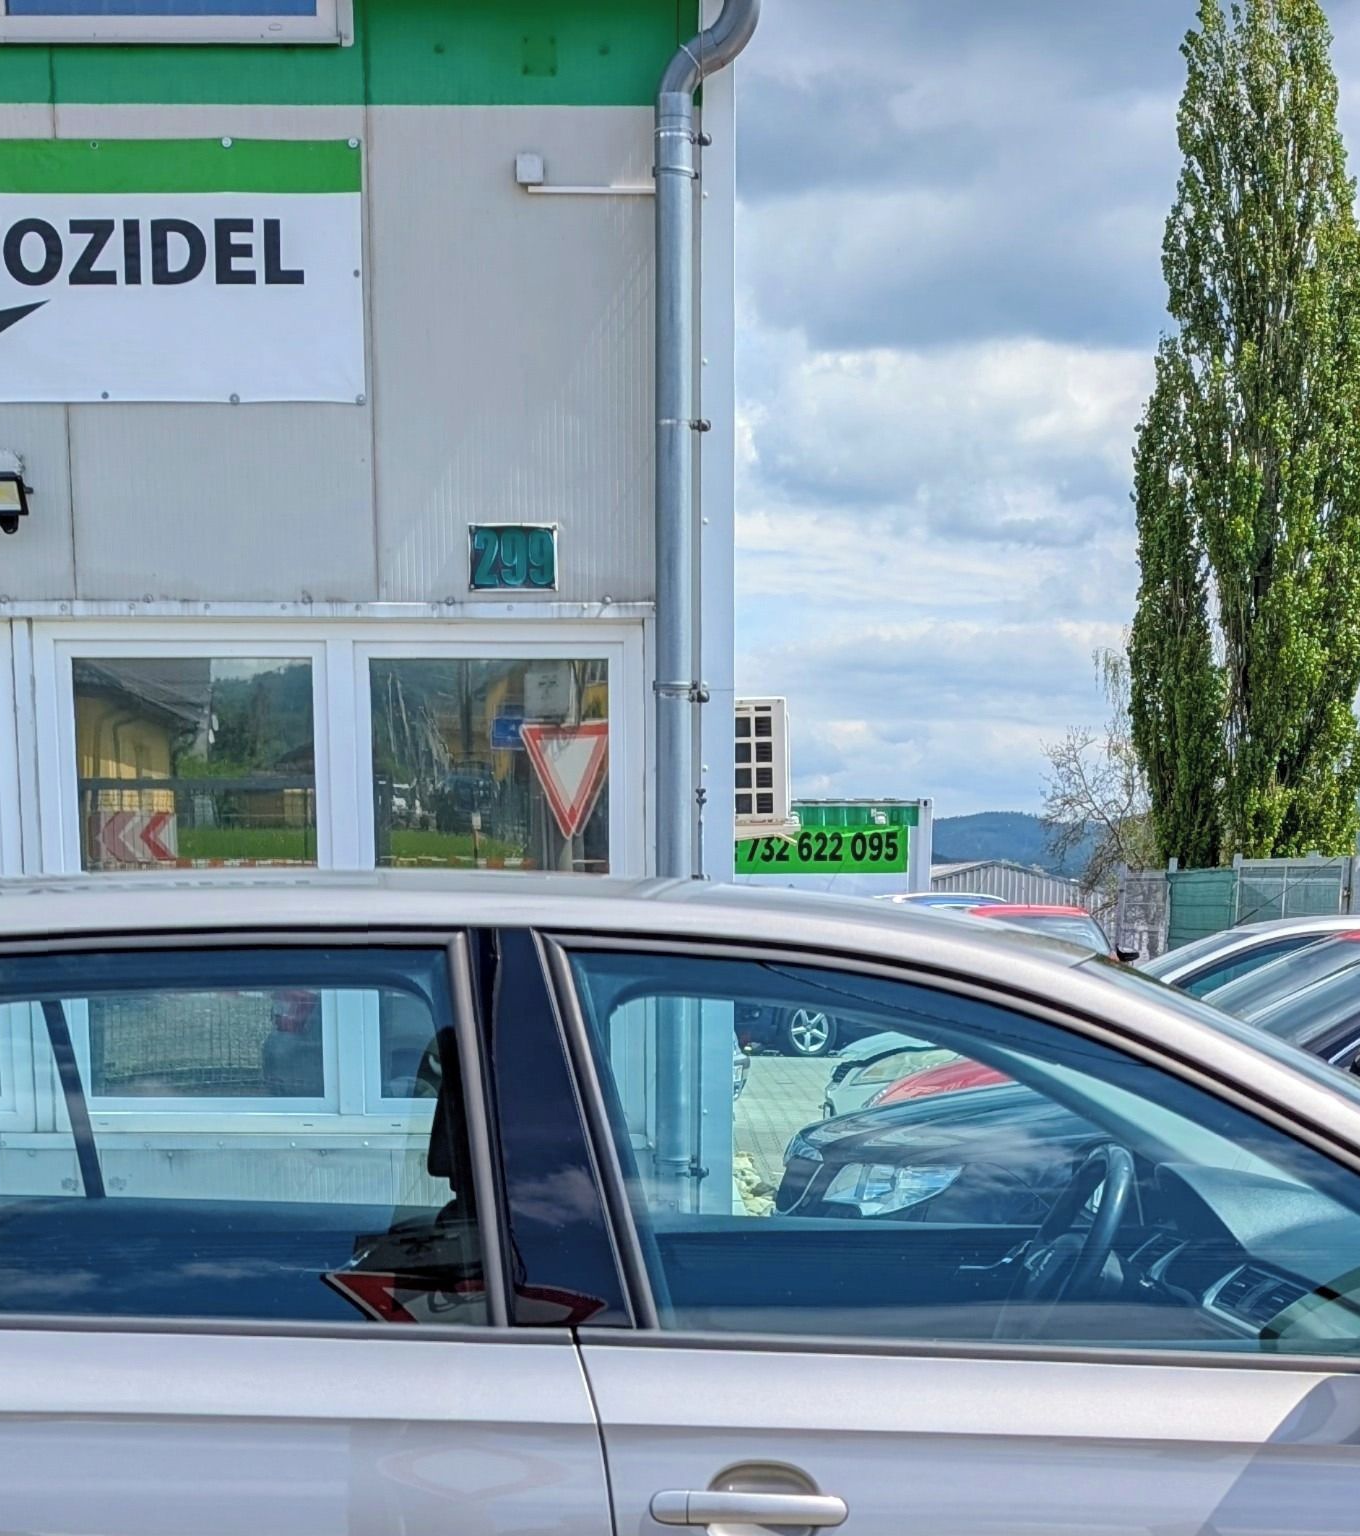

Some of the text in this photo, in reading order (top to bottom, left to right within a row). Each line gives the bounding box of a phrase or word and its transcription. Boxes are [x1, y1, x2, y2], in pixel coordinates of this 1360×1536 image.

[474, 528, 554, 585] 299
[797, 832, 844, 862] 622
[850, 832, 899, 862] 095
